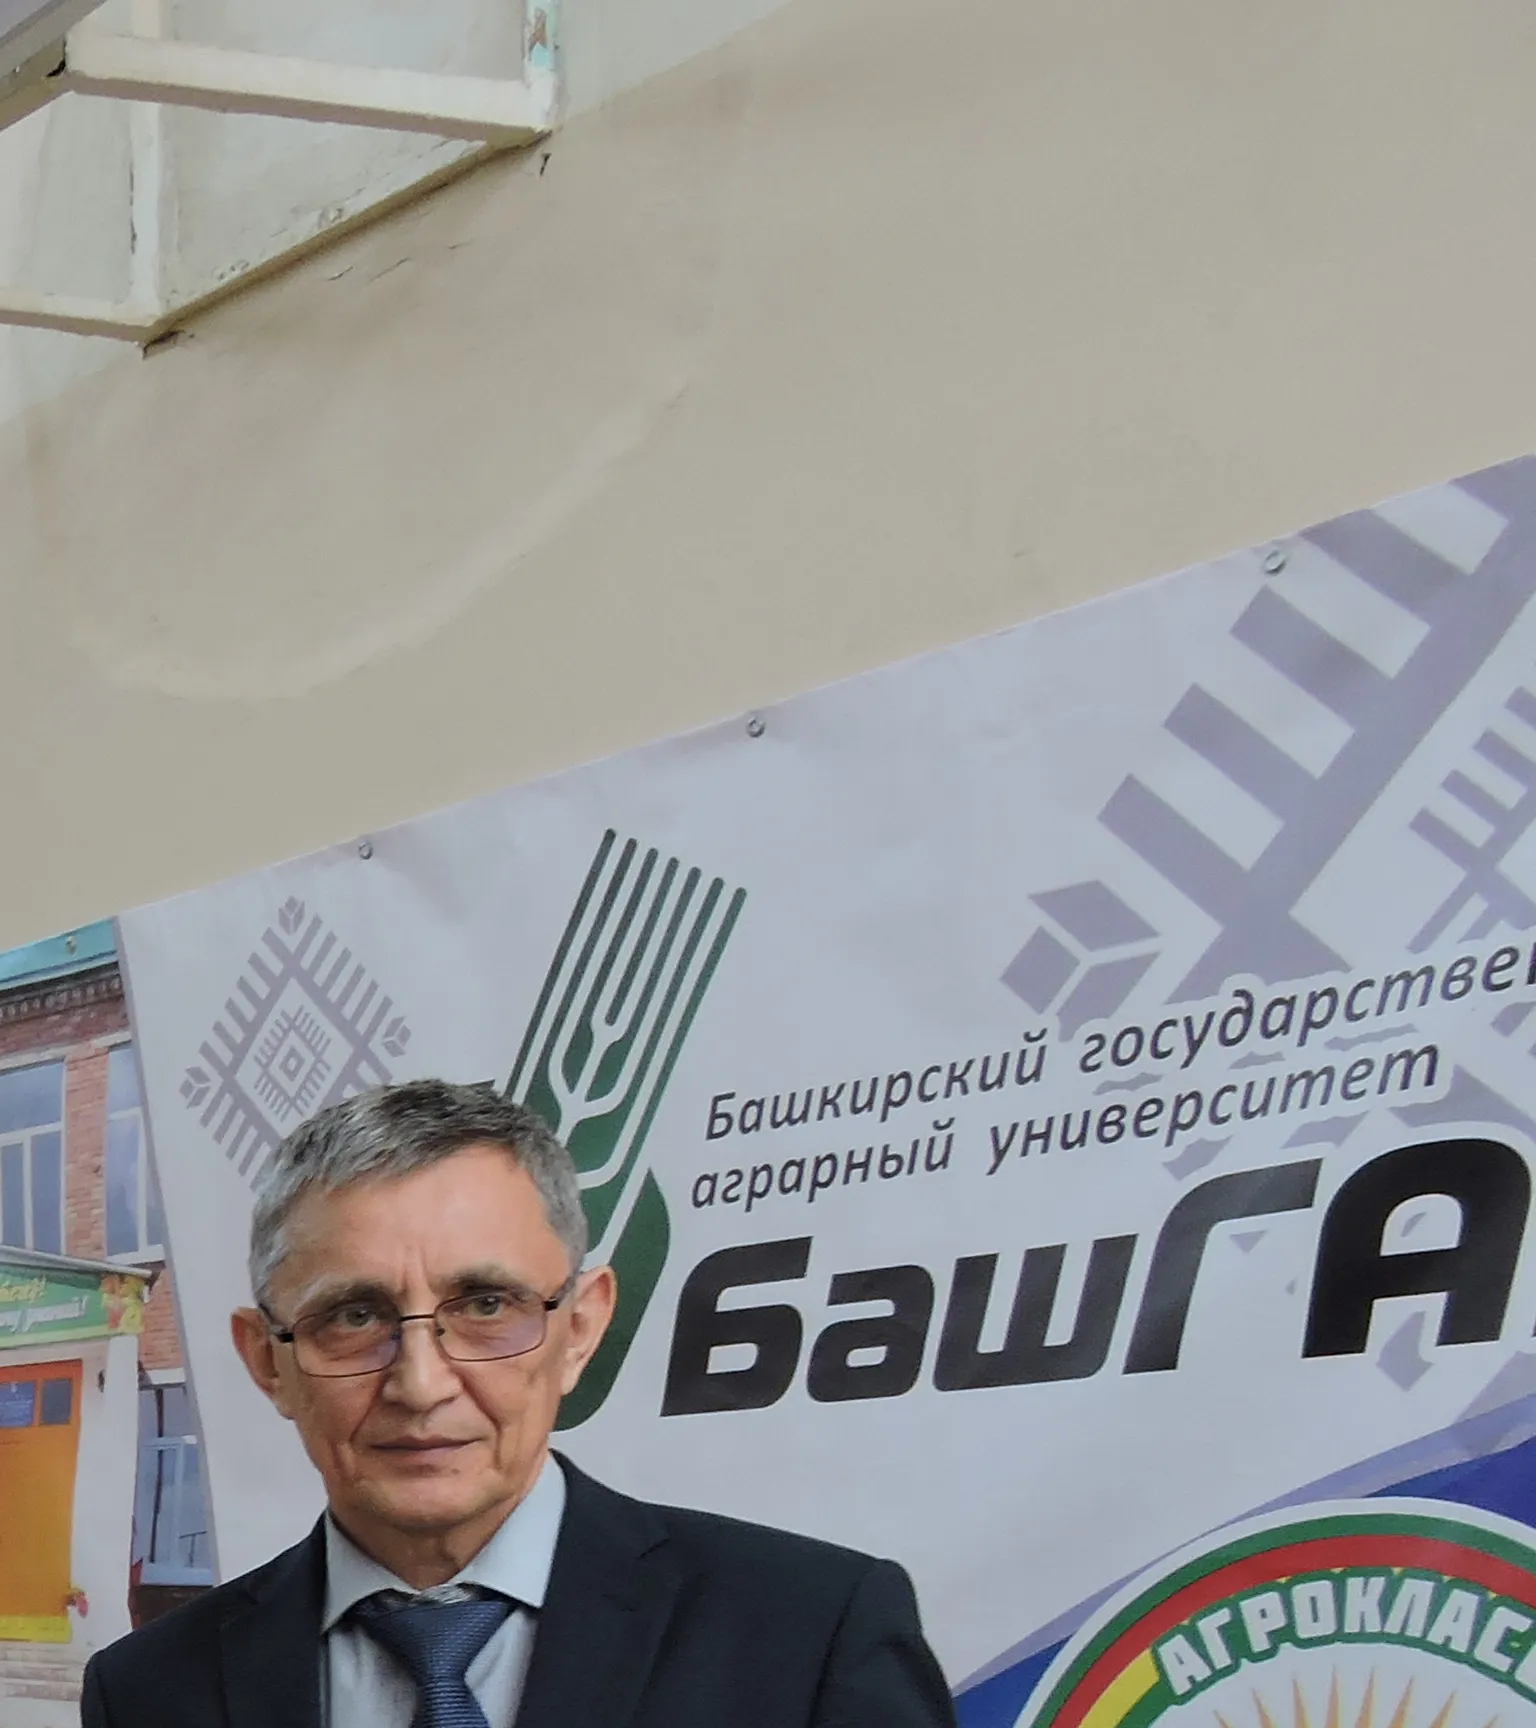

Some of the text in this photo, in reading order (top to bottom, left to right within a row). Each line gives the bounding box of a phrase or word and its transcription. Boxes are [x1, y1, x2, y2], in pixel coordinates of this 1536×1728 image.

[691, 1044, 1439, 1213] аграрный университет
[705, 941, 1536, 1141] Башкирский государстве
[659, 1138, 1536, 1418] БашГА
